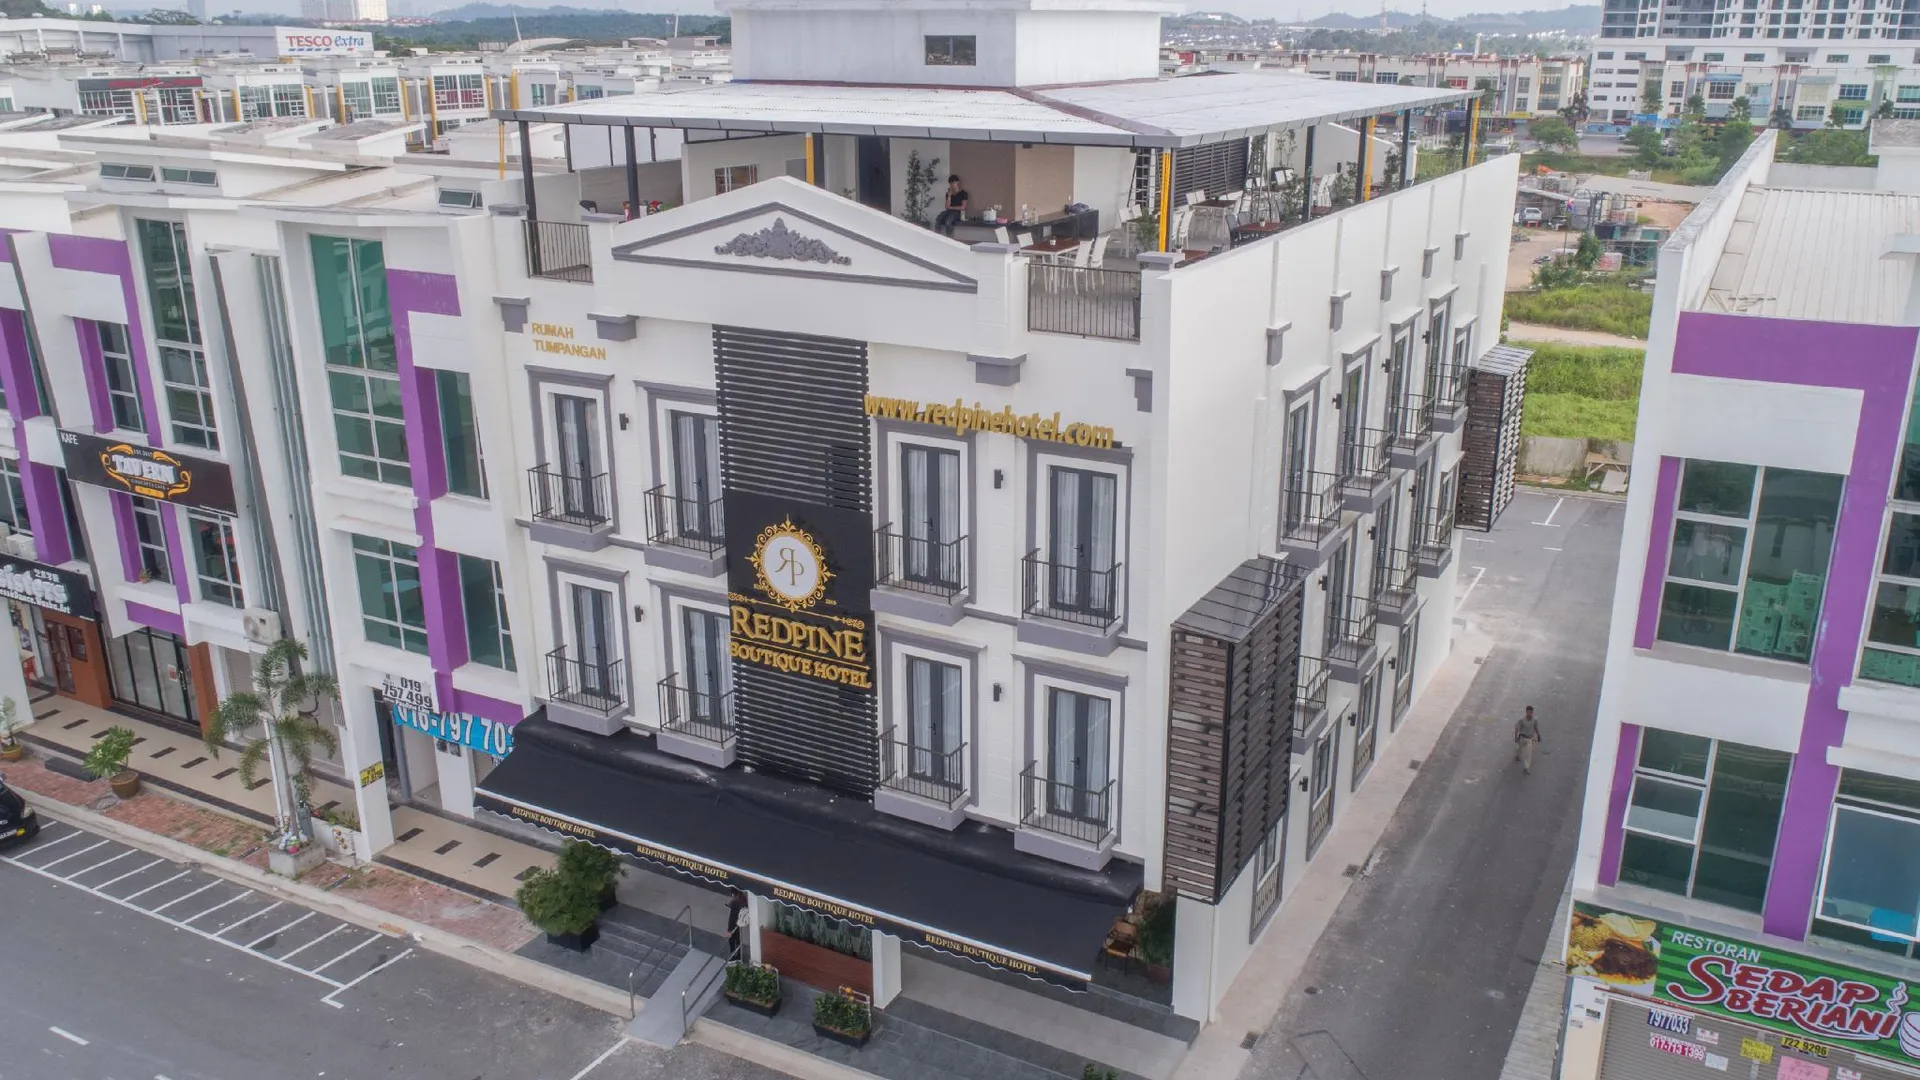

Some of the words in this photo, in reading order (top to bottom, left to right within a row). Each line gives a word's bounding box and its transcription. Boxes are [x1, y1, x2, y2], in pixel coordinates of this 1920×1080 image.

[288, 36, 332, 47] TESCO
[334, 36, 364, 46] extra
[532, 322, 574, 338] RUMAH
[533, 339, 606, 360] TUMPANGAN
[864, 394, 1114, 448] www.redpinehotel.com
[60, 433, 78, 445] KAFE
[112, 454, 176, 484] TAVERN
[731, 606, 866, 662] REDPINE
[730, 641, 812, 674] BOUTIQUE
[814, 662, 872, 688] HOTEL
[382, 682, 404, 698] 757
[406, 690, 433, 708] 499
[400, 677, 422, 692] 019
[512, 806, 540, 821] REDPINE
[540, 813, 573, 831] BOUTIQUE
[574, 824, 596, 838] HOTEL
[636, 845, 666, 860] REDPINE
[667, 853, 704, 872] BOUTIQUE
[704, 865, 728, 879] HOTEL
[773, 887, 806, 903] REDPINE
[806, 896, 848, 916] BOUTIQUE
[848, 910, 875, 924] HOTEL
[925, 933, 961, 950] REDPINE
[963, 944, 1008, 965] BOUTIQUE
[1008, 958, 1038, 974] HOTEL
[1672, 930, 1761, 963] RESTORAN
[1666, 955, 1879, 1005] SEDAP
[1649, 1008, 1688, 1034] 7977033
[1724, 986, 1901, 1040] BERIANI
